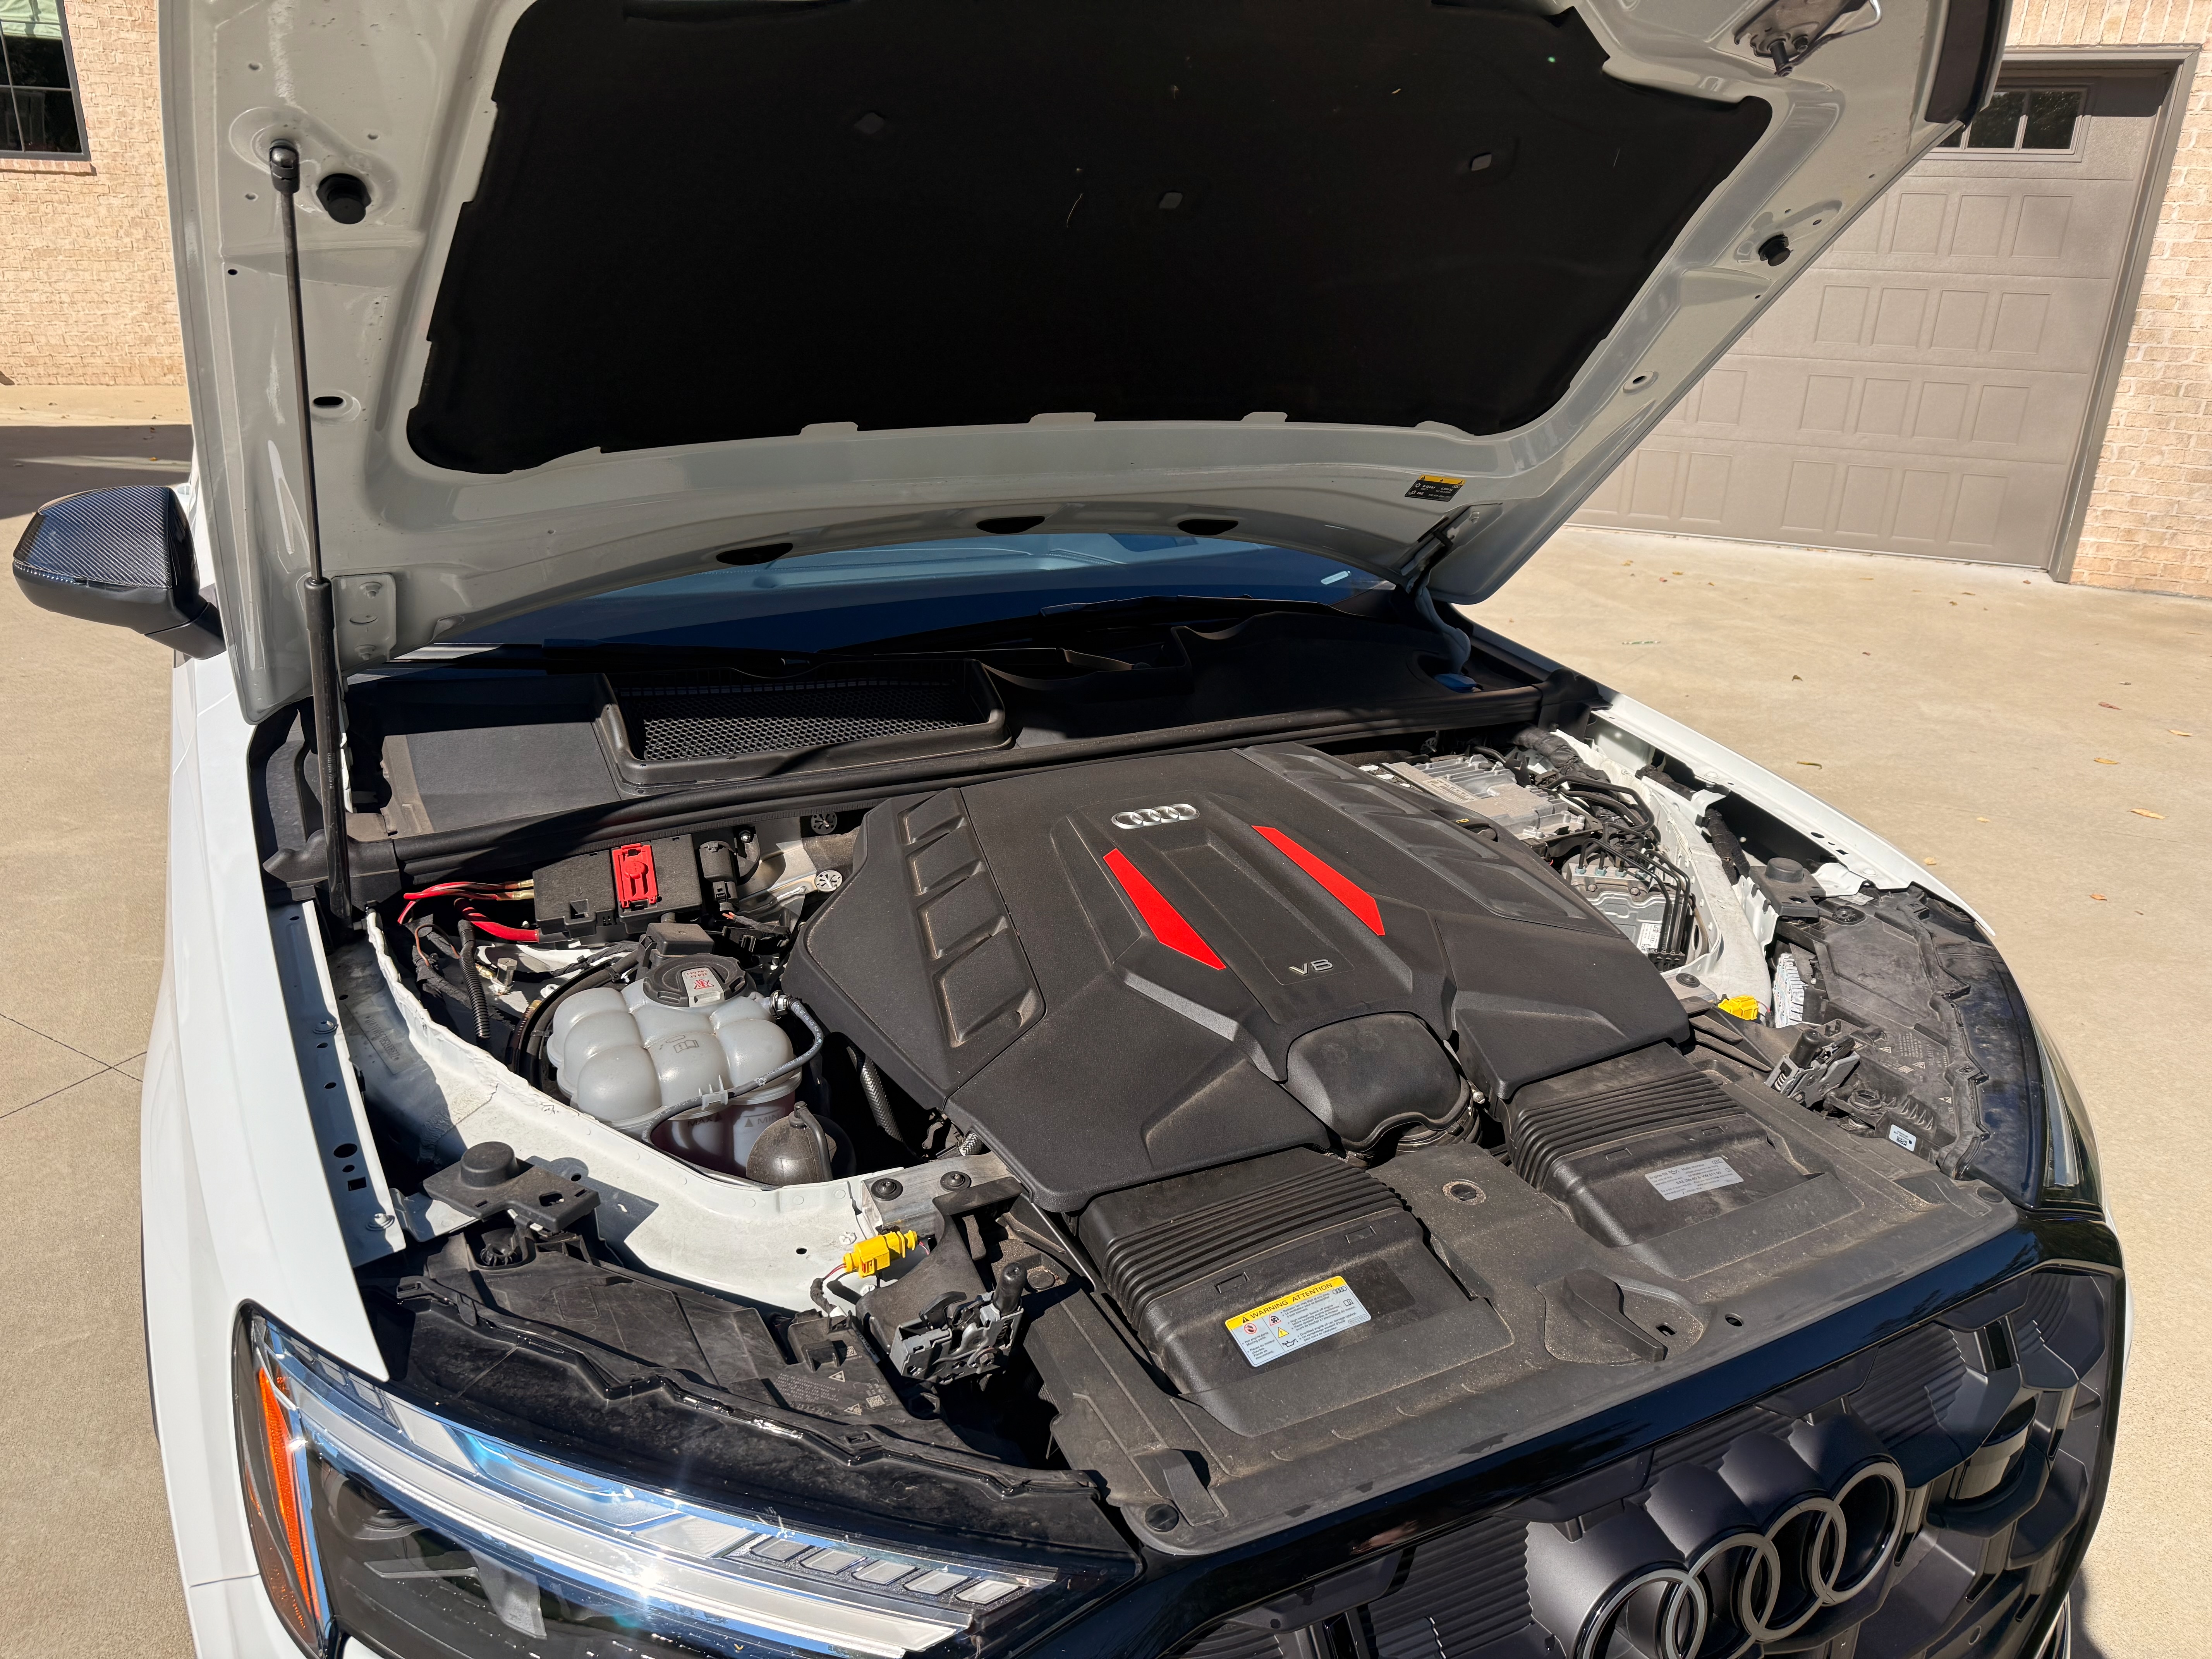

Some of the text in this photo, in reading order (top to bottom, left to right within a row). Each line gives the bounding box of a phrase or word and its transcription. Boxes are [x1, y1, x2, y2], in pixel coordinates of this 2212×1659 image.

[1289, 959, 1333, 975] V8
[687, 1116, 713, 1127] MAX
[757, 1114, 779, 1125] MIN
[1250, 1283, 1333, 1318] WARNING ATTENTION
